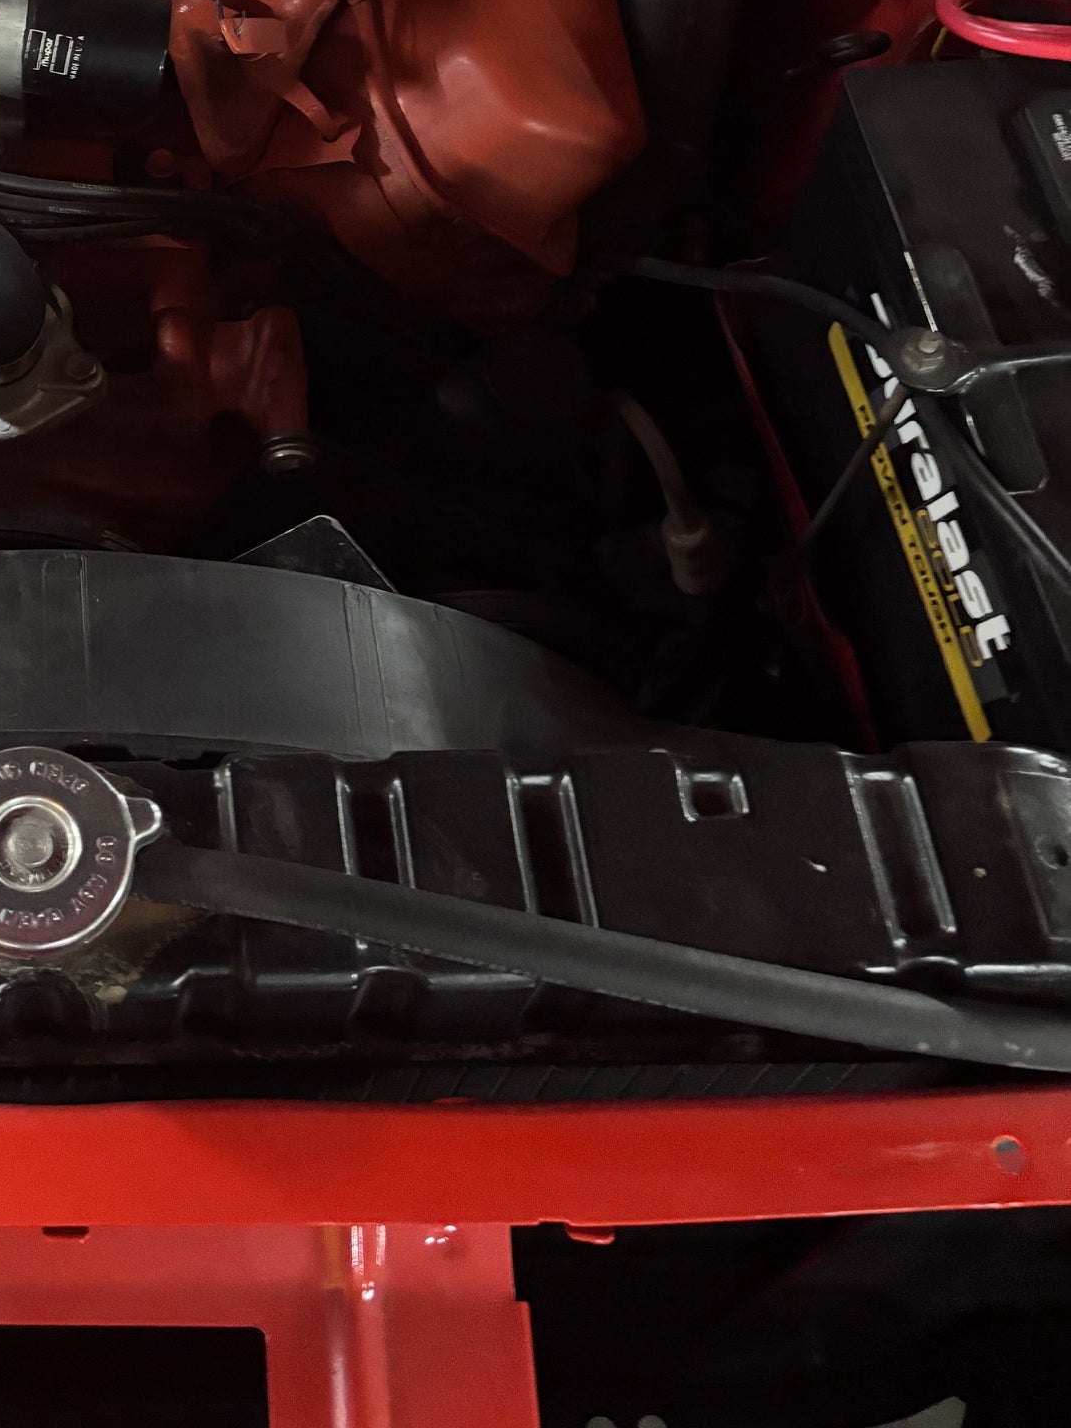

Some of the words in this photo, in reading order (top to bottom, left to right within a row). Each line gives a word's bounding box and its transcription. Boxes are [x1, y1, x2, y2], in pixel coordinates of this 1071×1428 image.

[858, 404, 908, 526] POVEN
[908, 540, 953, 644] TOUGH
[865, 292, 1011, 660] uralast
